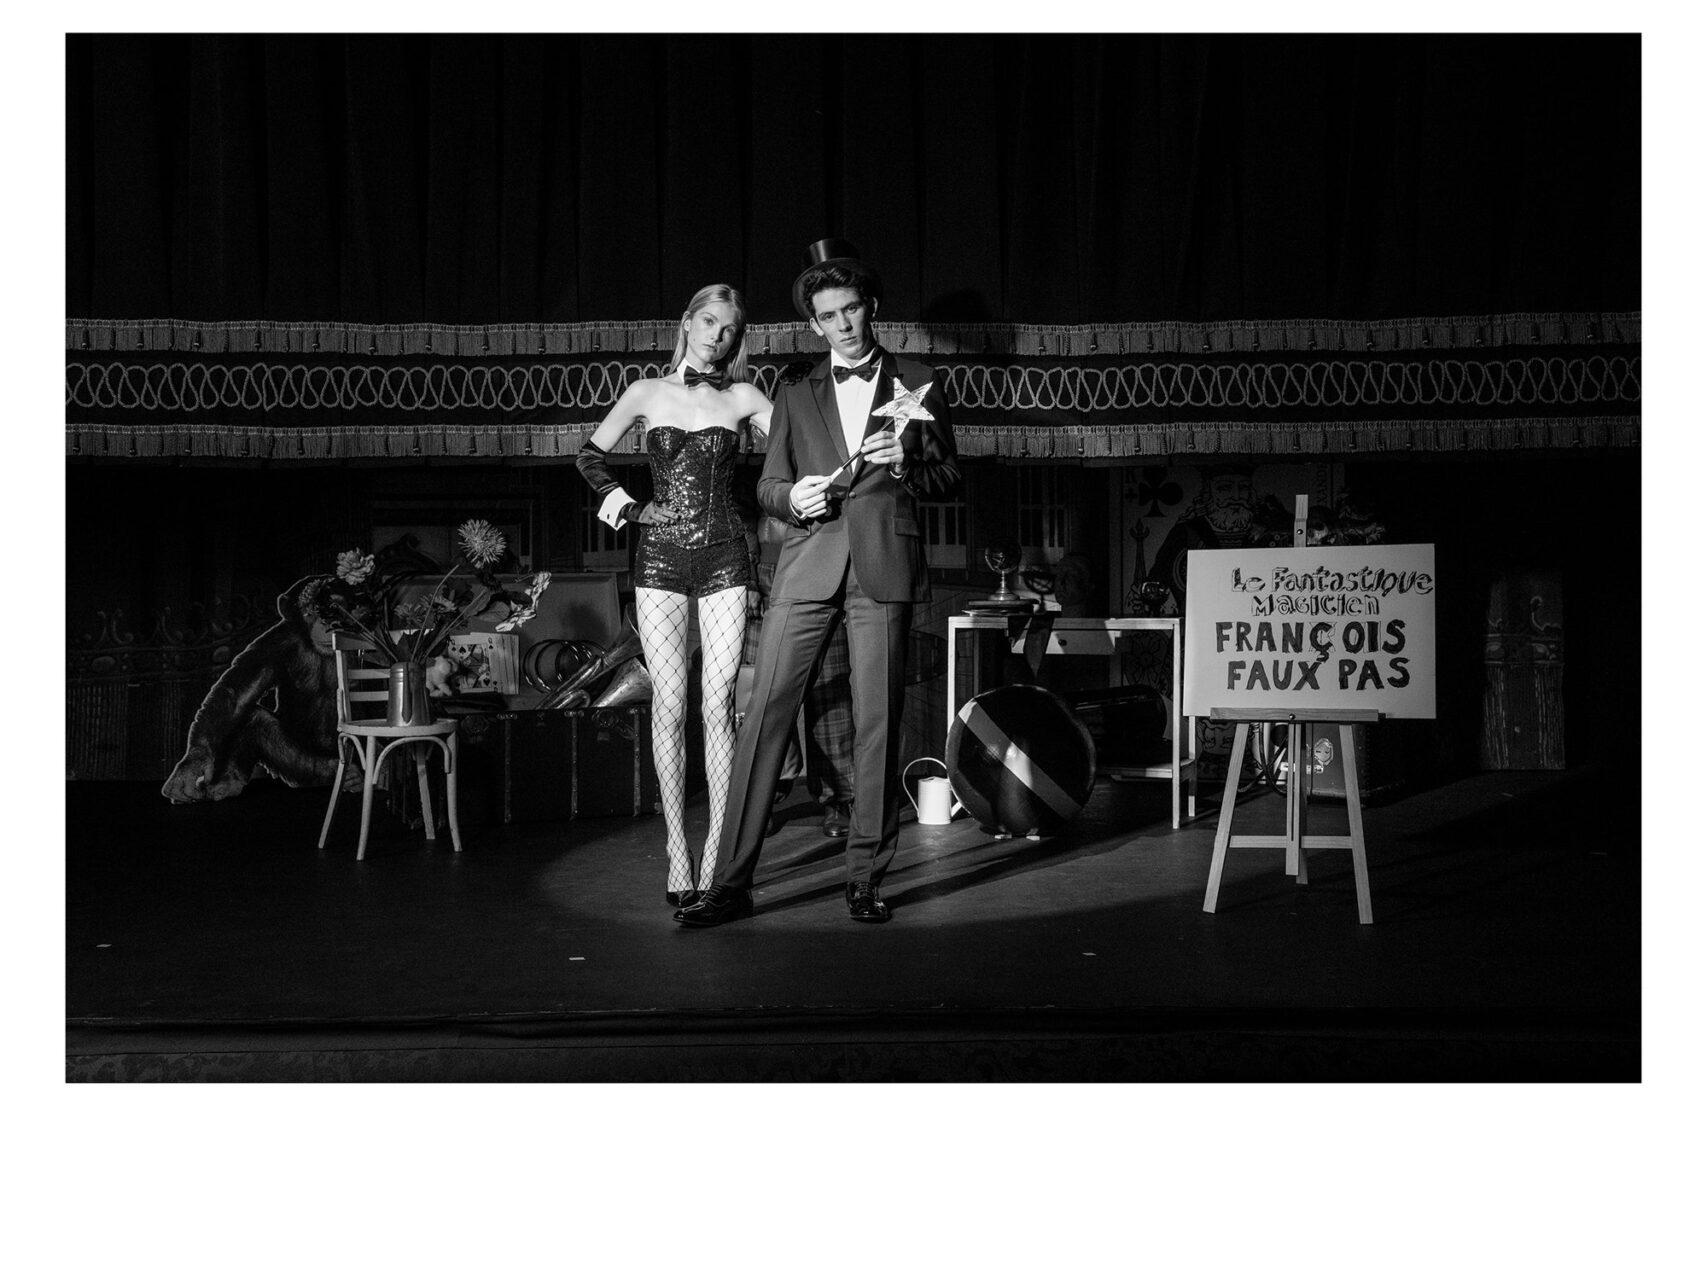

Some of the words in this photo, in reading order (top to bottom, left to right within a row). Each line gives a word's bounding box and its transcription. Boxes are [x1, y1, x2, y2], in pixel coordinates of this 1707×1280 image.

[1232, 567, 1266, 592] Le
[1216, 618, 1407, 662] FRANÇOIS
[1227, 659, 1322, 690] FAUX
[1338, 656, 1411, 690] PAS
